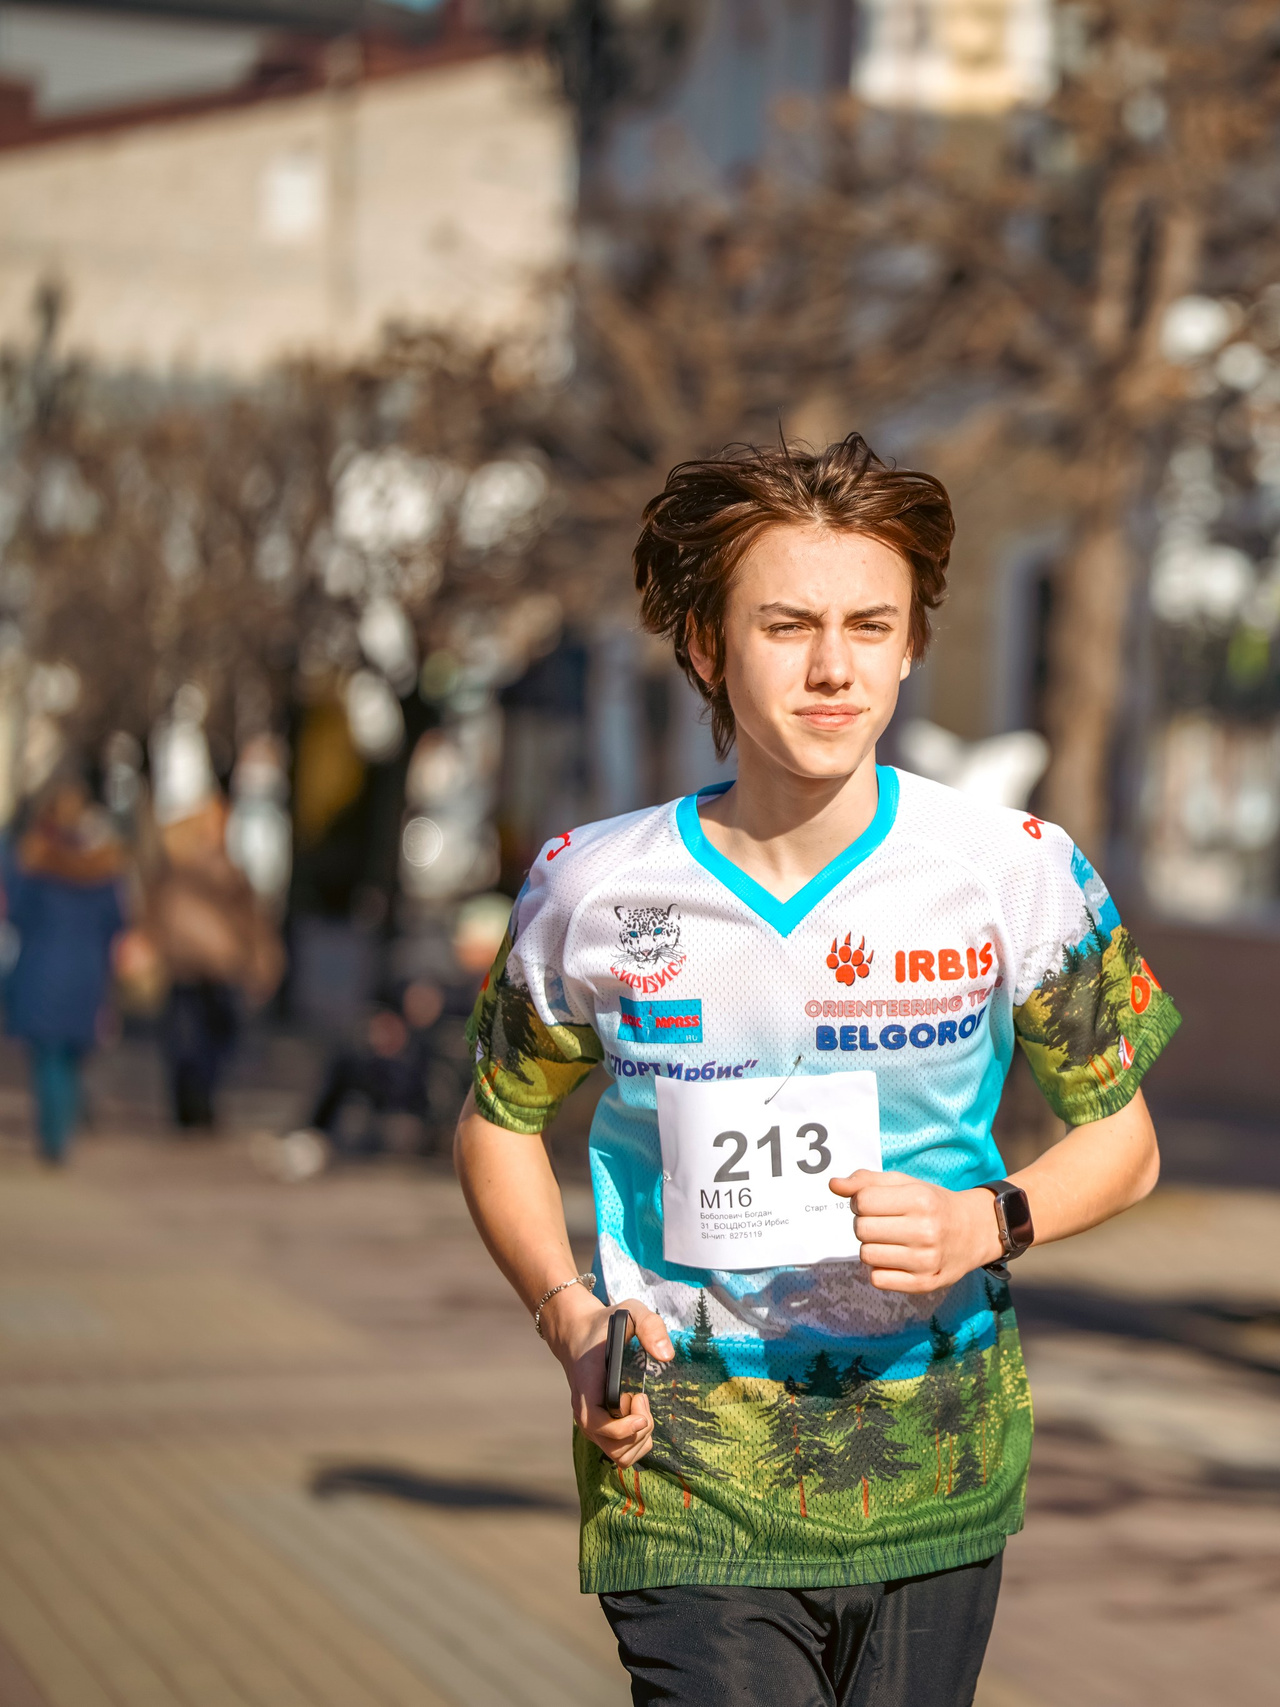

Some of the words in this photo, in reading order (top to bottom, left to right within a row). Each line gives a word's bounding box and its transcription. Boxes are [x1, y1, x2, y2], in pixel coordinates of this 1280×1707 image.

[895, 942, 993, 983] IRBIS
[804, 995, 963, 1018] ORIENTEERING
[968, 979, 1000, 1007] TEA
[609, 1056, 661, 1077] ПОРТ
[712, 1122, 832, 1183] 213
[700, 1187, 753, 1209] M16
[699, 1211, 742, 1220] Боболович
[744, 1209, 773, 1218] Богдан
[700, 1220, 763, 1231] 31_БОЦДЮТиЭ
[764, 1218, 790, 1228] Ирбис
[729, 1230, 763, 1239] 8275119
